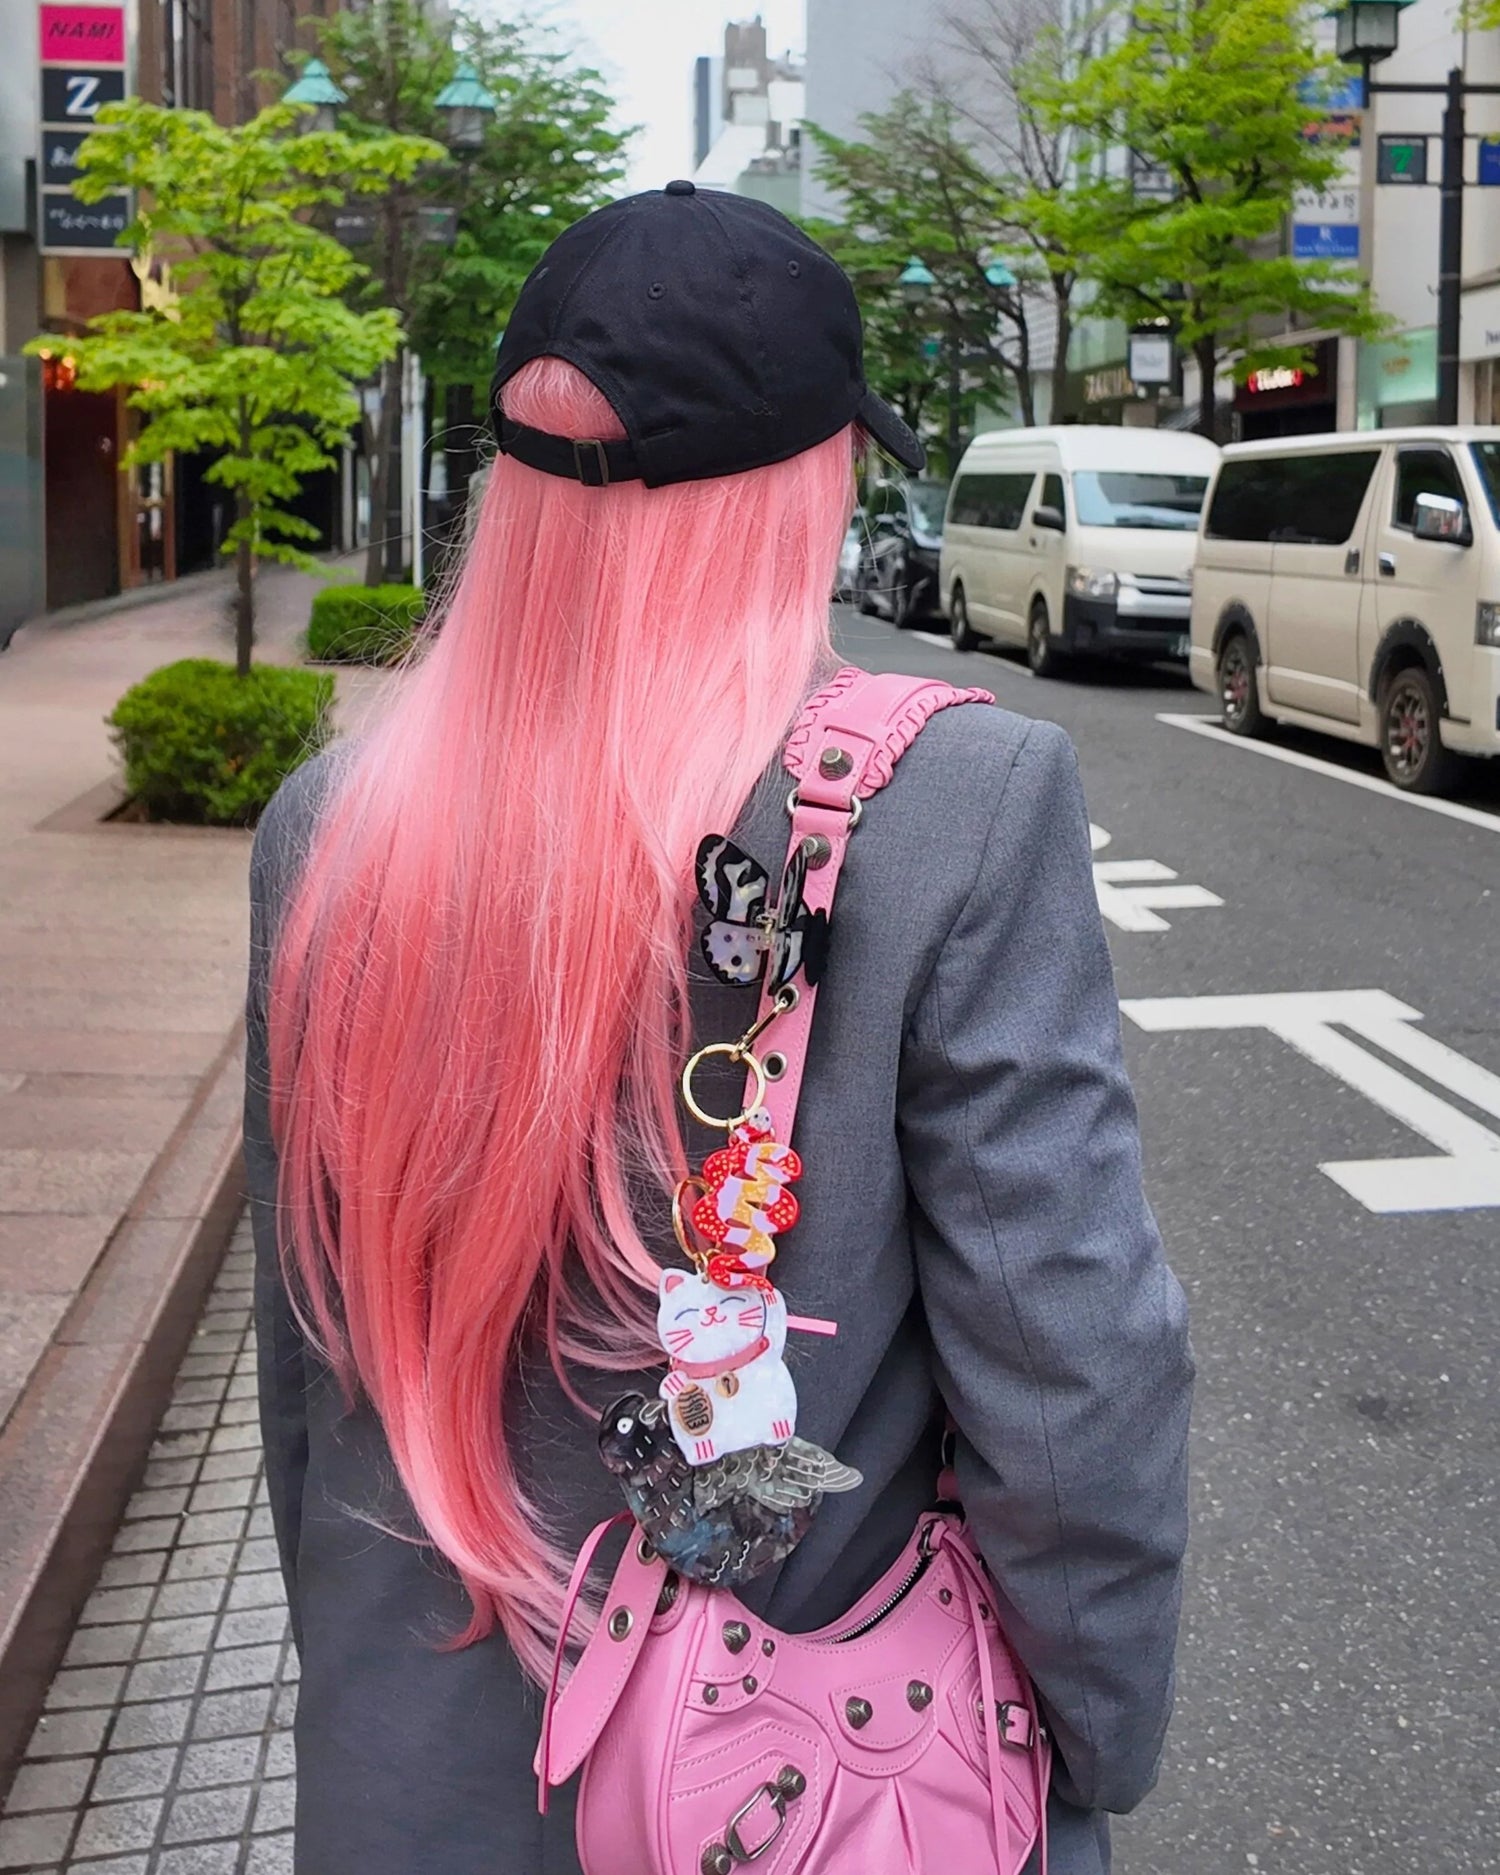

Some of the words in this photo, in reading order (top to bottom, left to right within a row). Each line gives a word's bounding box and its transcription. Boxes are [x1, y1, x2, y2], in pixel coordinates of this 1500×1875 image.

[49, 20, 116, 39] NAMI
[66, 76, 100, 115] Z
[1390, 145, 1414, 174] 7
